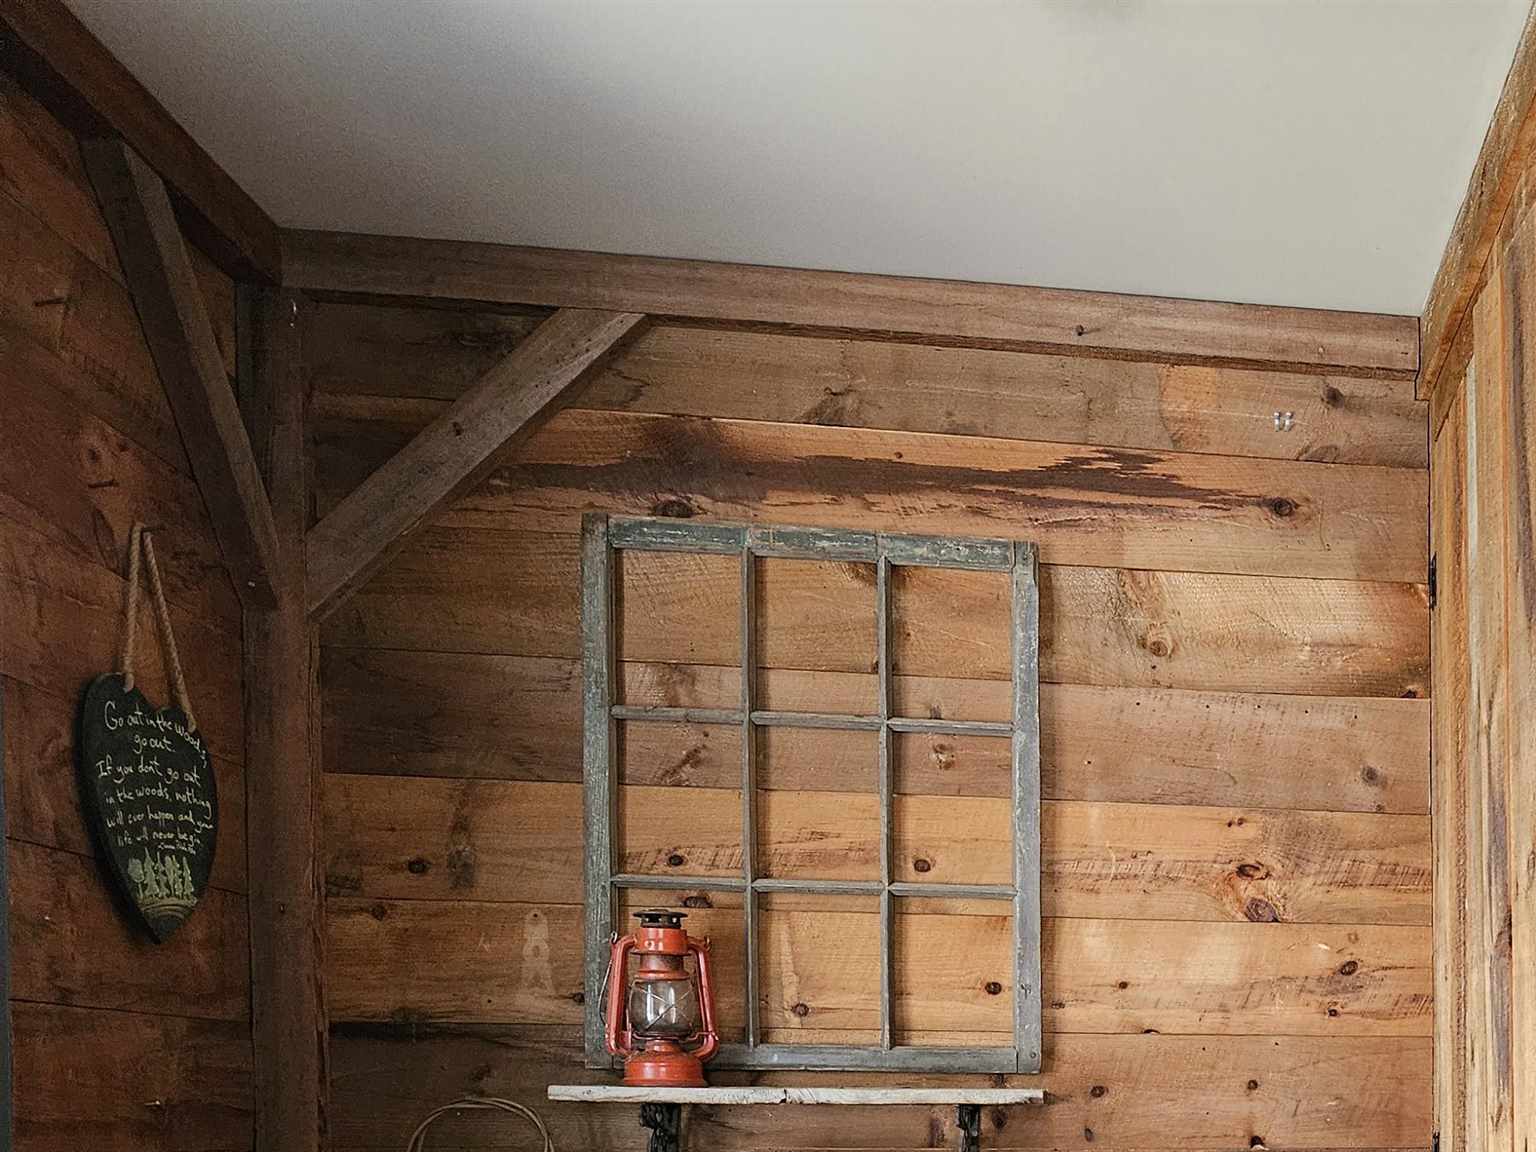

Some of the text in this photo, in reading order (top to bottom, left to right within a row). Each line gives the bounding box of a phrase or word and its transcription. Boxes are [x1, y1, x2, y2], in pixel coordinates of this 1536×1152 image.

[105, 700, 125, 730] Go
[127, 703, 144, 725] out
[146, 715, 157, 728] in
[156, 712, 173, 732] the
[133, 734, 147, 754] go
[96, 754, 112, 778] If
[113, 766, 133, 783] you
[165, 768, 179, 784] go
[184, 765, 201, 788] out
[116, 786, 135, 803] the
[175, 787, 212, 819] nothing
